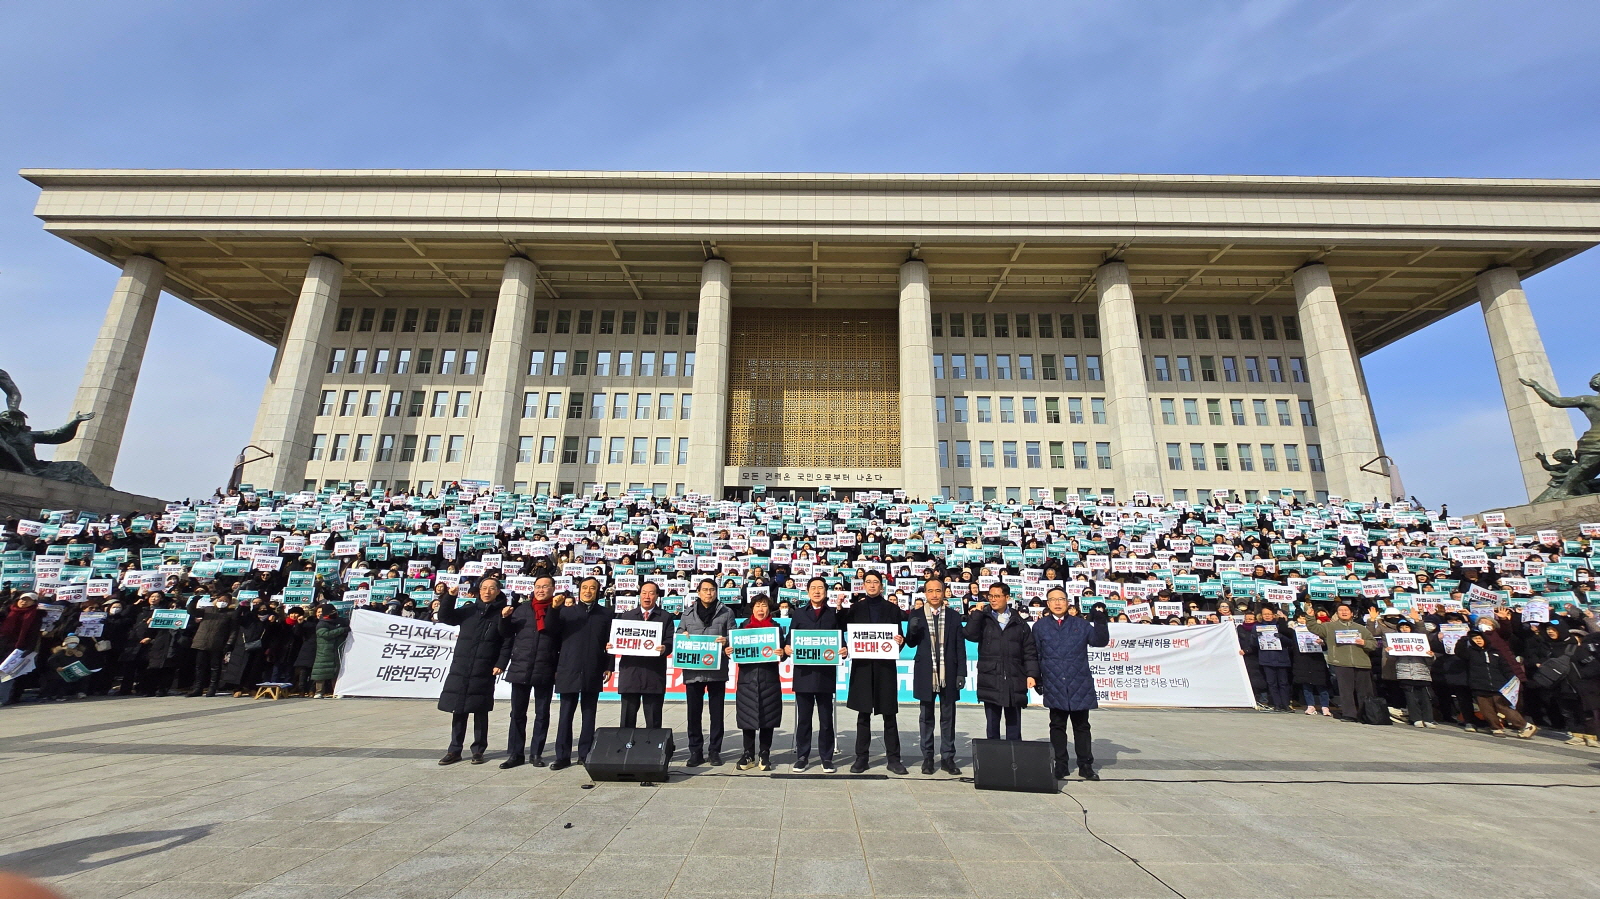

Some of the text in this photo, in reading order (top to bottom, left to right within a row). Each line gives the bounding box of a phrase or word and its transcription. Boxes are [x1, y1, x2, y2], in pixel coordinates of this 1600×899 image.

[742, 472, 883, 482] 모든 권력은 국민으로부터 나온다
[386, 623, 454, 641] 우리 자녀가
[616, 627, 657, 638] 차별금지법
[853, 630, 893, 640] 차별금지법
[616, 638, 641, 650] 반대!
[733, 634, 775, 645] 차별금지법
[795, 636, 838, 646] 차별금지법
[1120, 639, 1136, 648] 약물
[1138, 639, 1153, 648] 낙태
[1154, 638, 1171, 648] 허용
[1172, 639, 1190, 648] 반대
[677, 640, 718, 651] 차별금지법
[854, 641, 878, 653] 반대!
[1394, 644, 1413, 652] 반대!
[381, 643, 454, 661] 한국 교회가
[735, 647, 759, 659] 반대!
[796, 648, 820, 660] 반대!
[1112, 652, 1129, 661] 반대
[677, 653, 700, 664] 반대!
[376, 665, 445, 682] 대한민국이
[1108, 665, 1124, 675] 성별
[1126, 665, 1142, 675] 변경
[1143, 665, 1161, 675] 반대
[1096, 677, 1190, 688] 반대(동성결합 허용 반대)
[1110, 691, 1128, 701] 반대
